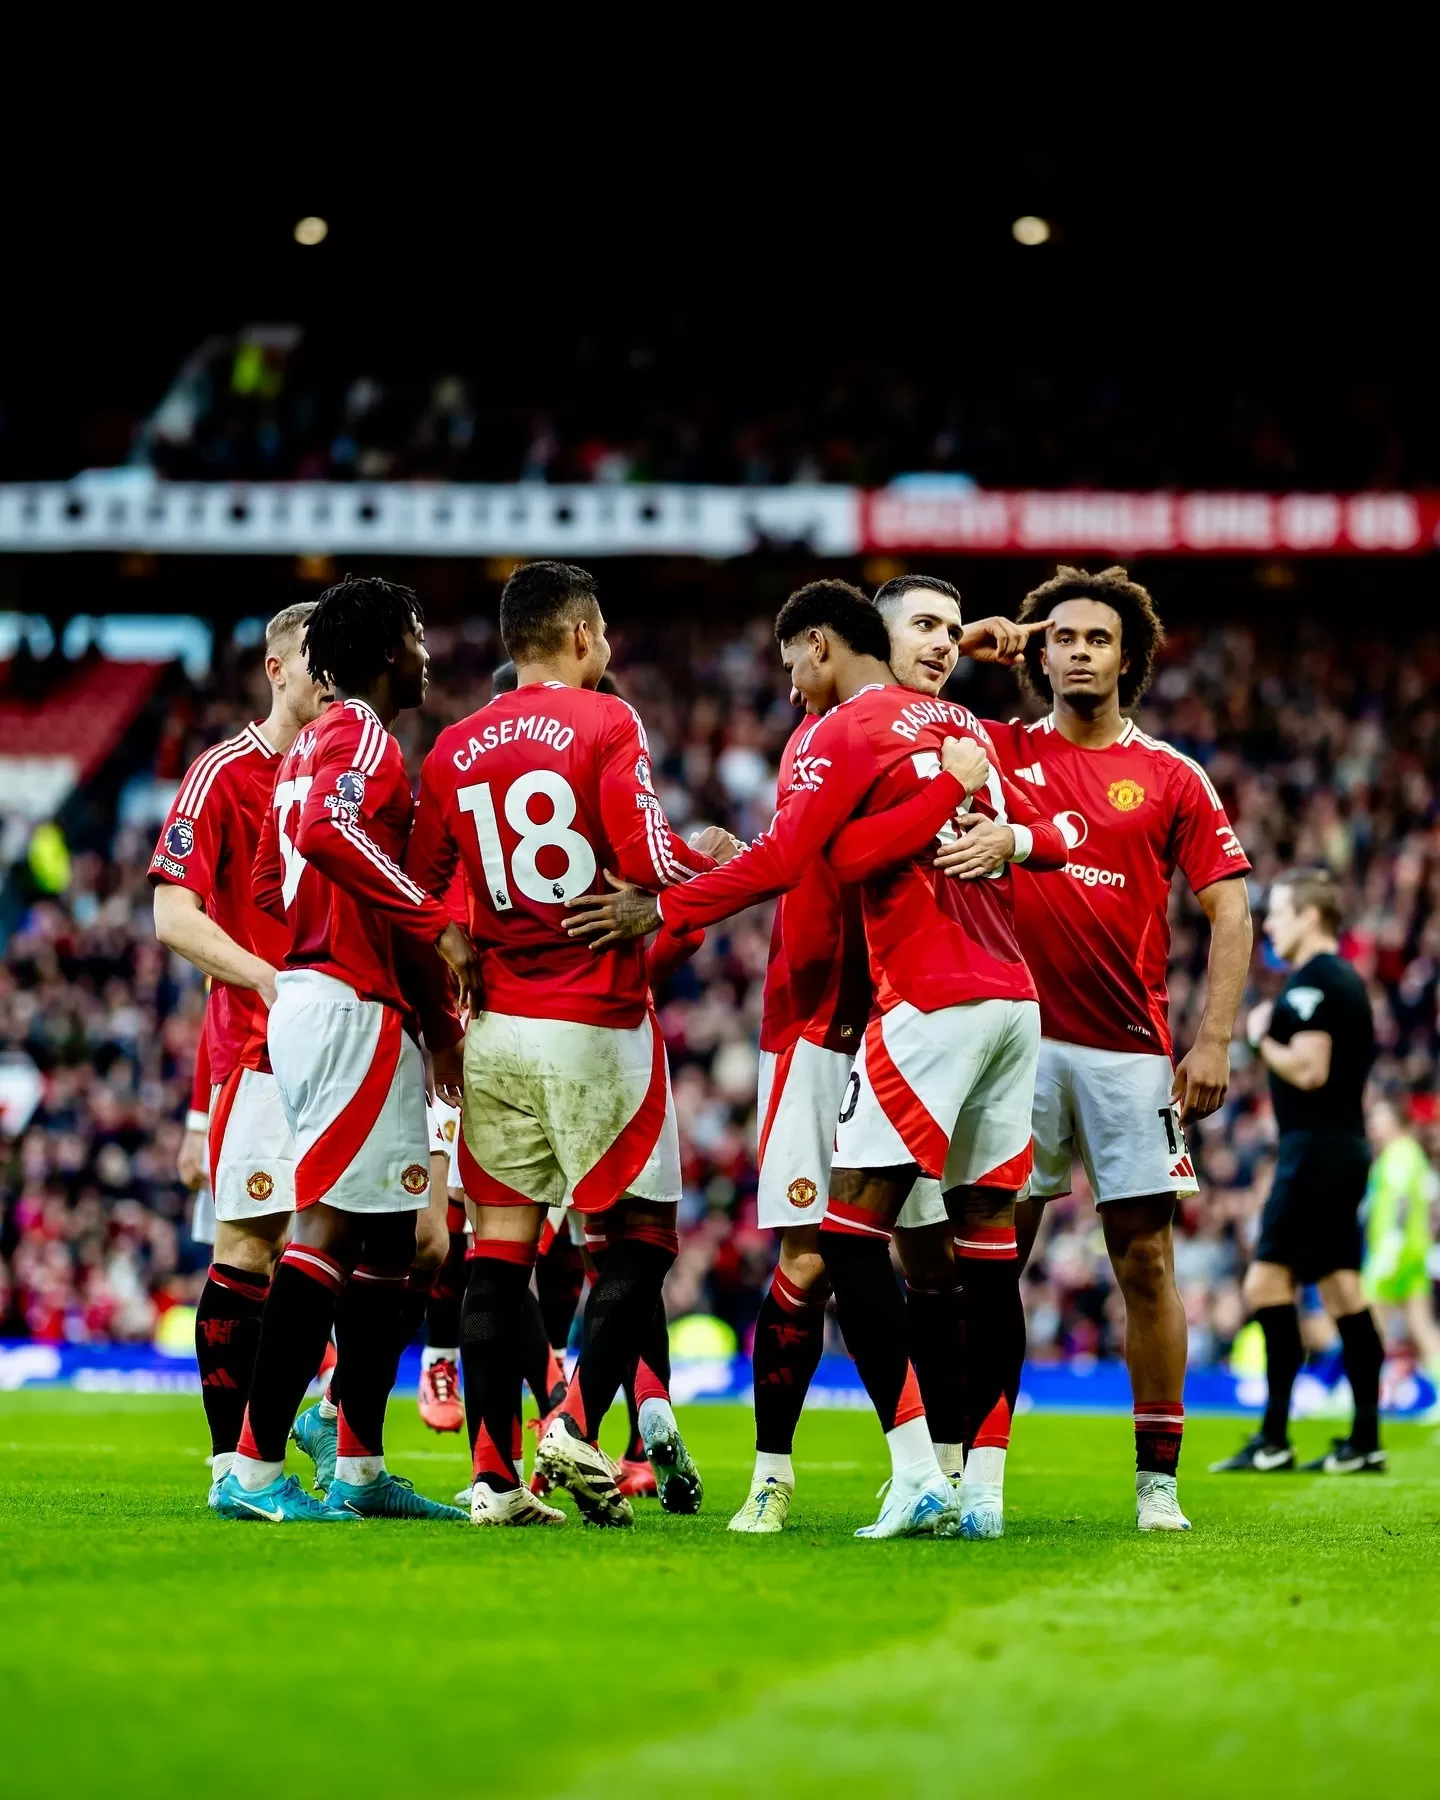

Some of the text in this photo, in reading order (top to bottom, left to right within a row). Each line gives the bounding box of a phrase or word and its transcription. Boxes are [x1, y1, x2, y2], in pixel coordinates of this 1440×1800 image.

[453, 715, 574, 772] CASEMIRO
[891, 701, 991, 745] RASHFORD
[457, 769, 597, 911] 18
[164, 857, 184, 872] room
[1058, 861, 1126, 889] ragon
